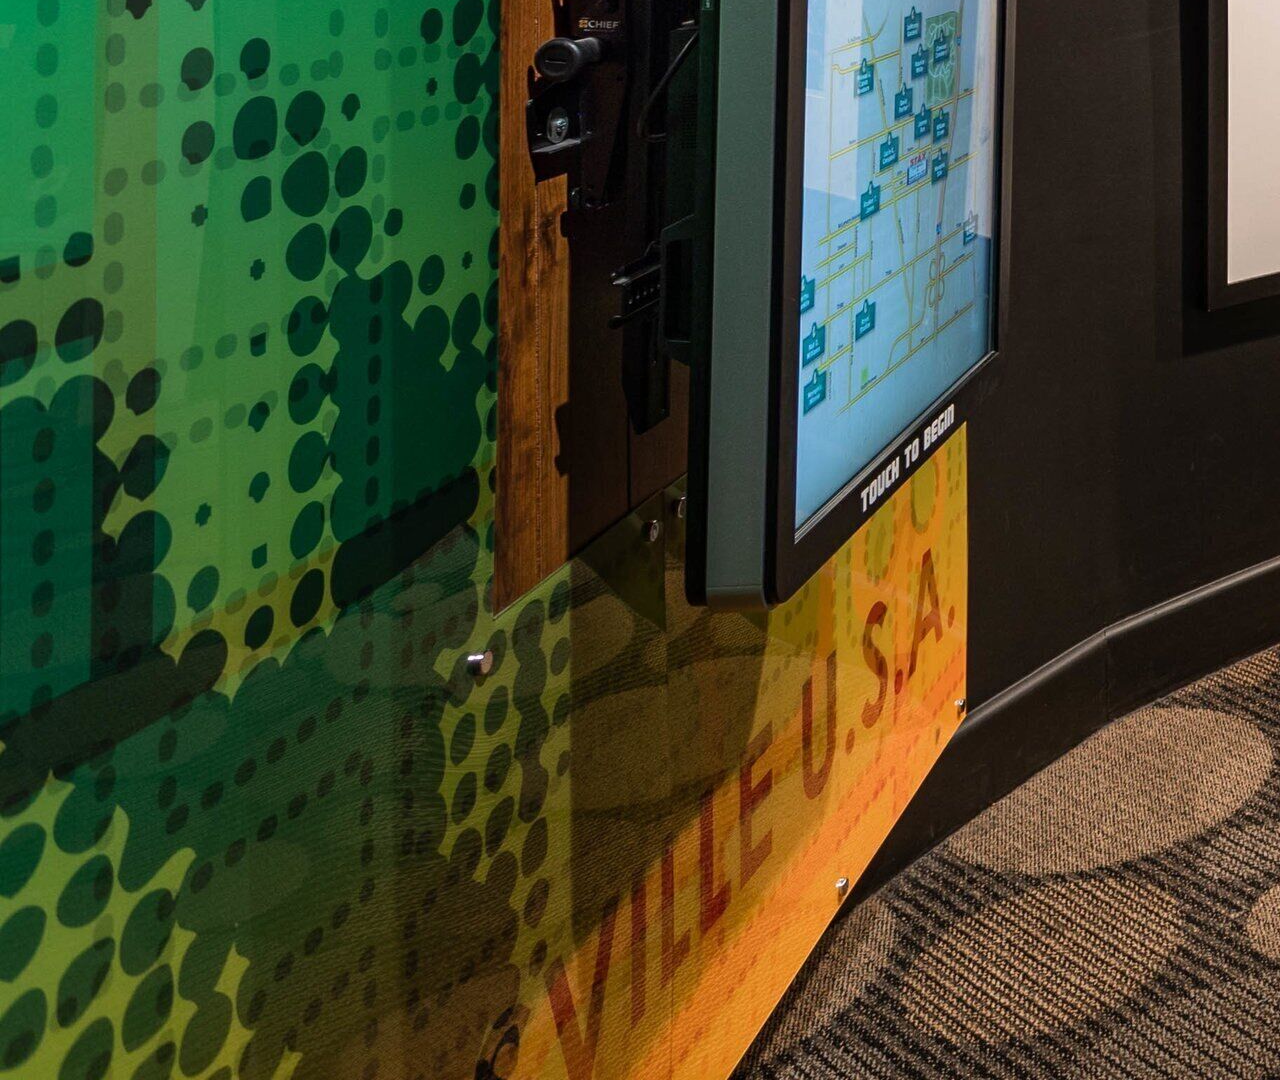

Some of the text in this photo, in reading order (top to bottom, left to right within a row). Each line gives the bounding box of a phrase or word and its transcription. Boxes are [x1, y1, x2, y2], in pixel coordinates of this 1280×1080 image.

[860, 403, 955, 513] TOUCH TO BEGIN
[801, 547, 957, 800] U.S.A.
